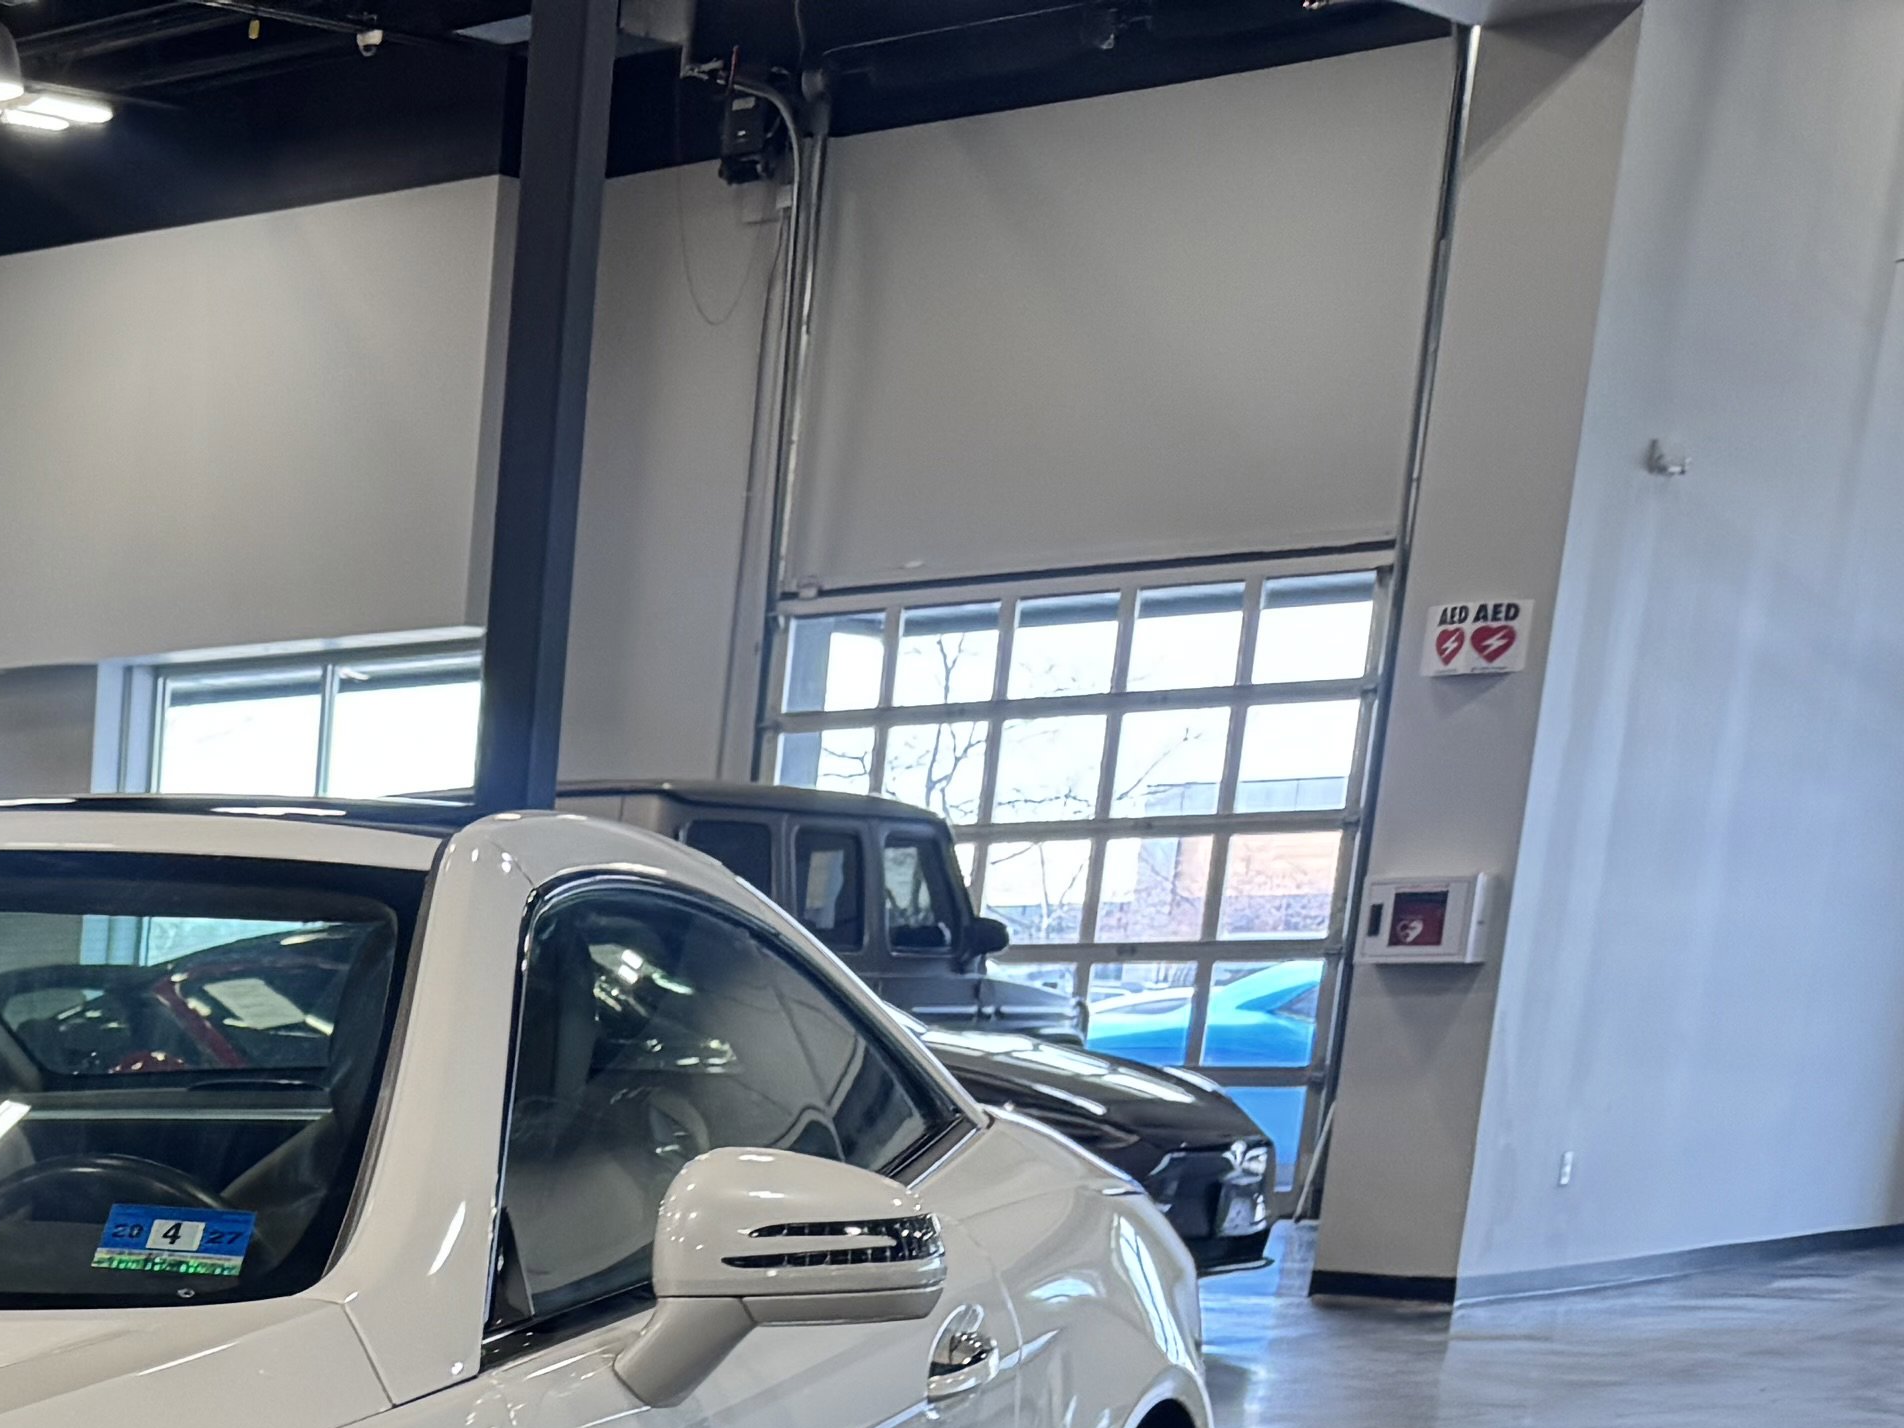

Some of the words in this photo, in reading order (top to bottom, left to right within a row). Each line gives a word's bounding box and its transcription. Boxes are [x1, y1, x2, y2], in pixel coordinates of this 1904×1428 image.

[1438, 605, 1470, 627] AED
[1473, 602, 1521, 624] AED
[113, 1223, 145, 1239] 20
[162, 1222, 182, 1245] 4
[206, 1230, 243, 1245] 27
